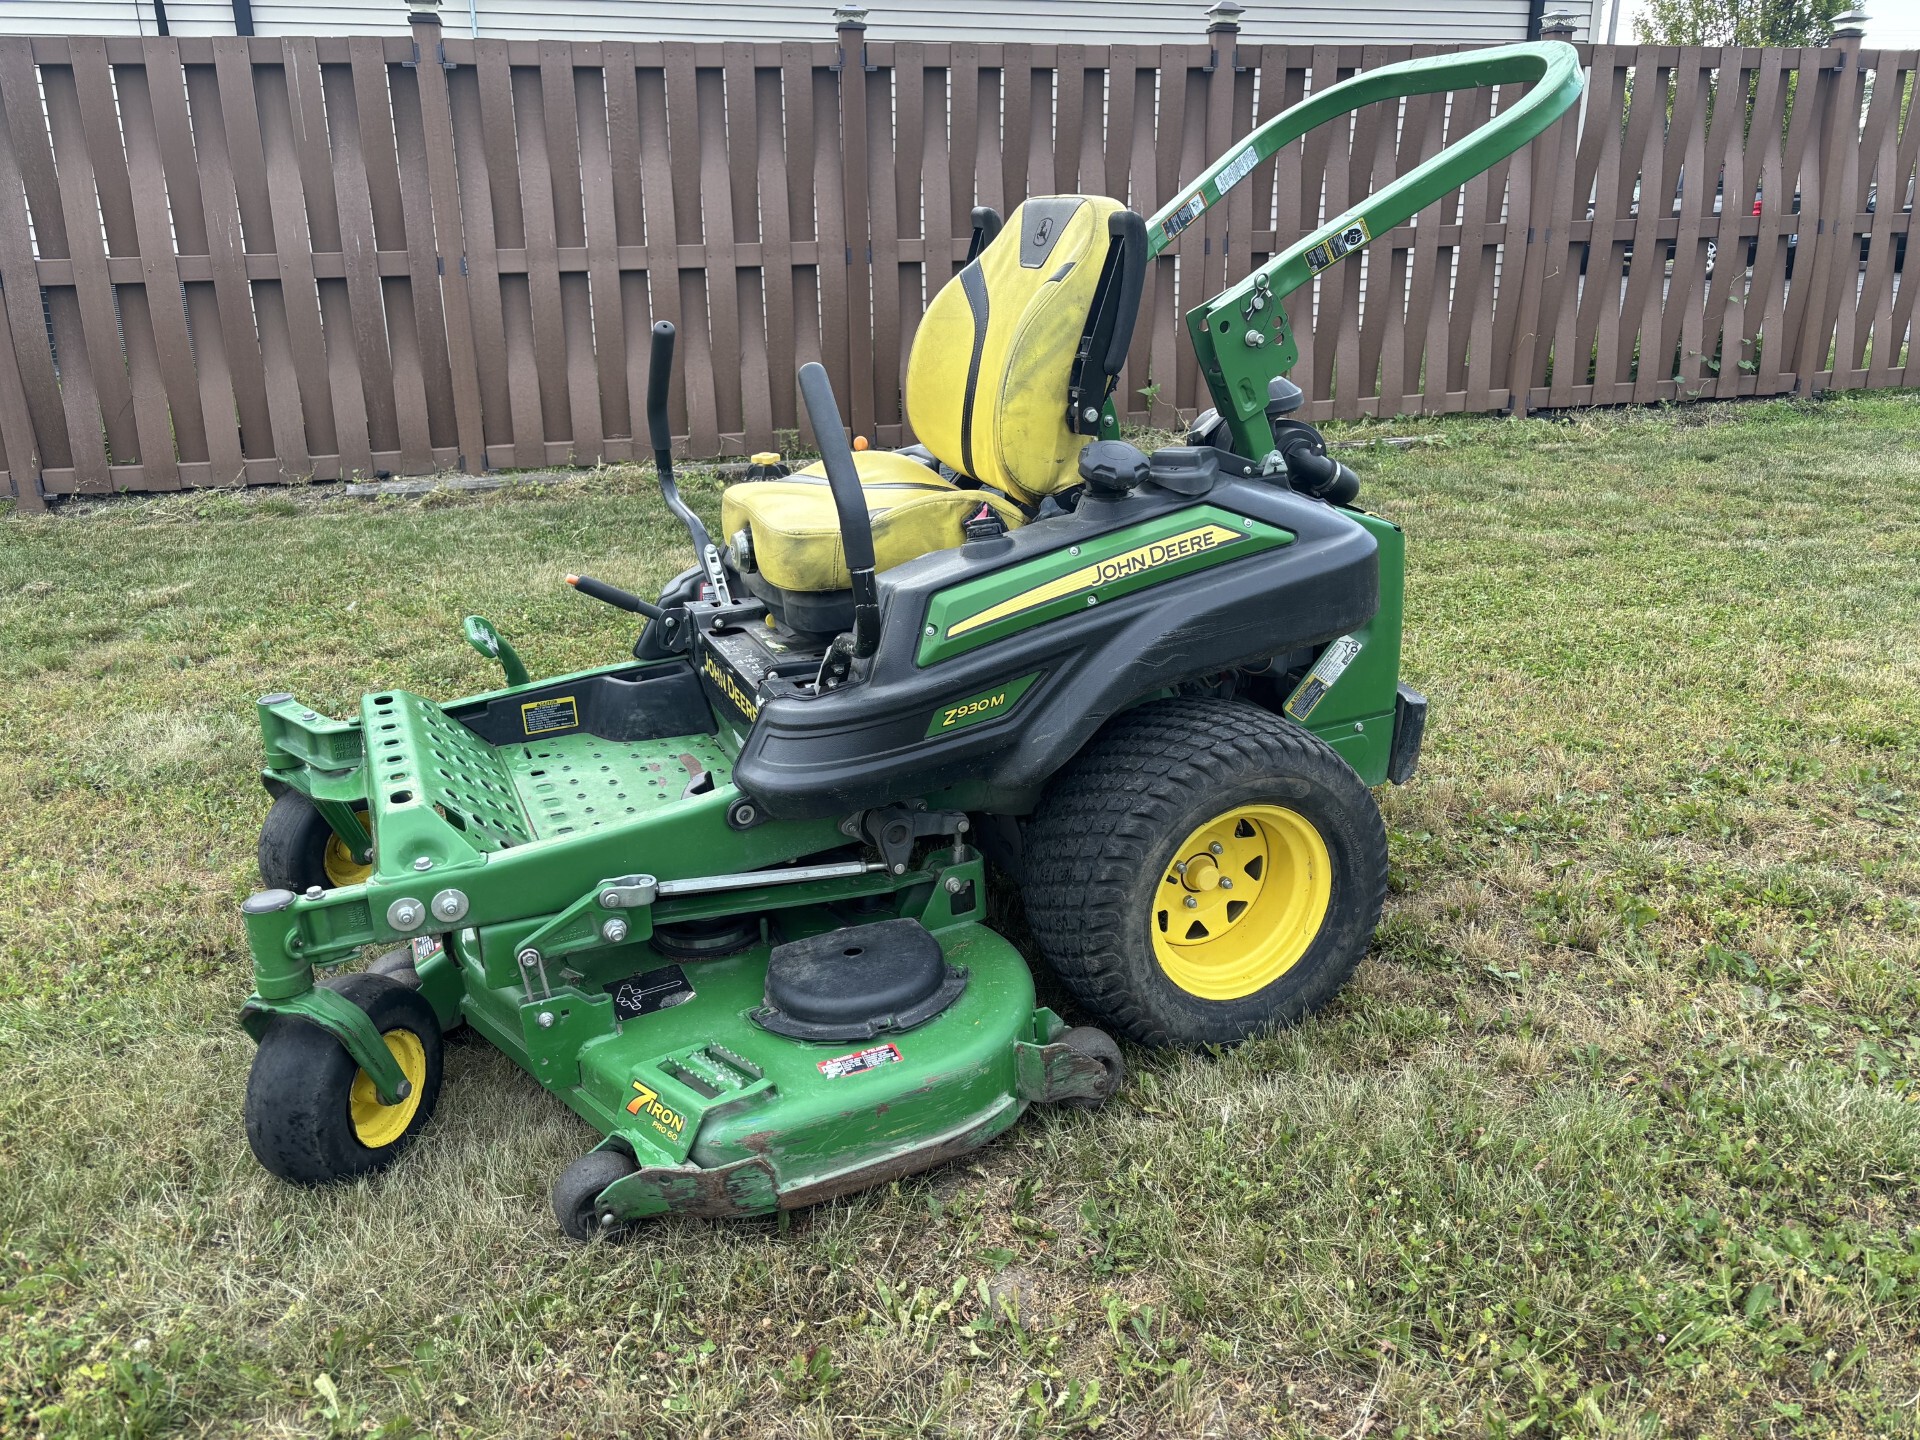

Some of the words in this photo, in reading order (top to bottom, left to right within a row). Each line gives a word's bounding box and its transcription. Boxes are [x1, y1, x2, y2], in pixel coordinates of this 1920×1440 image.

[1092, 553, 1146, 584] JOHN
[1149, 531, 1216, 564] DEERE
[705, 651, 727, 692] JOHN
[942, 693, 1005, 726] Z930M
[652, 1120, 667, 1133] PRO
[667, 1130, 678, 1141] 60
